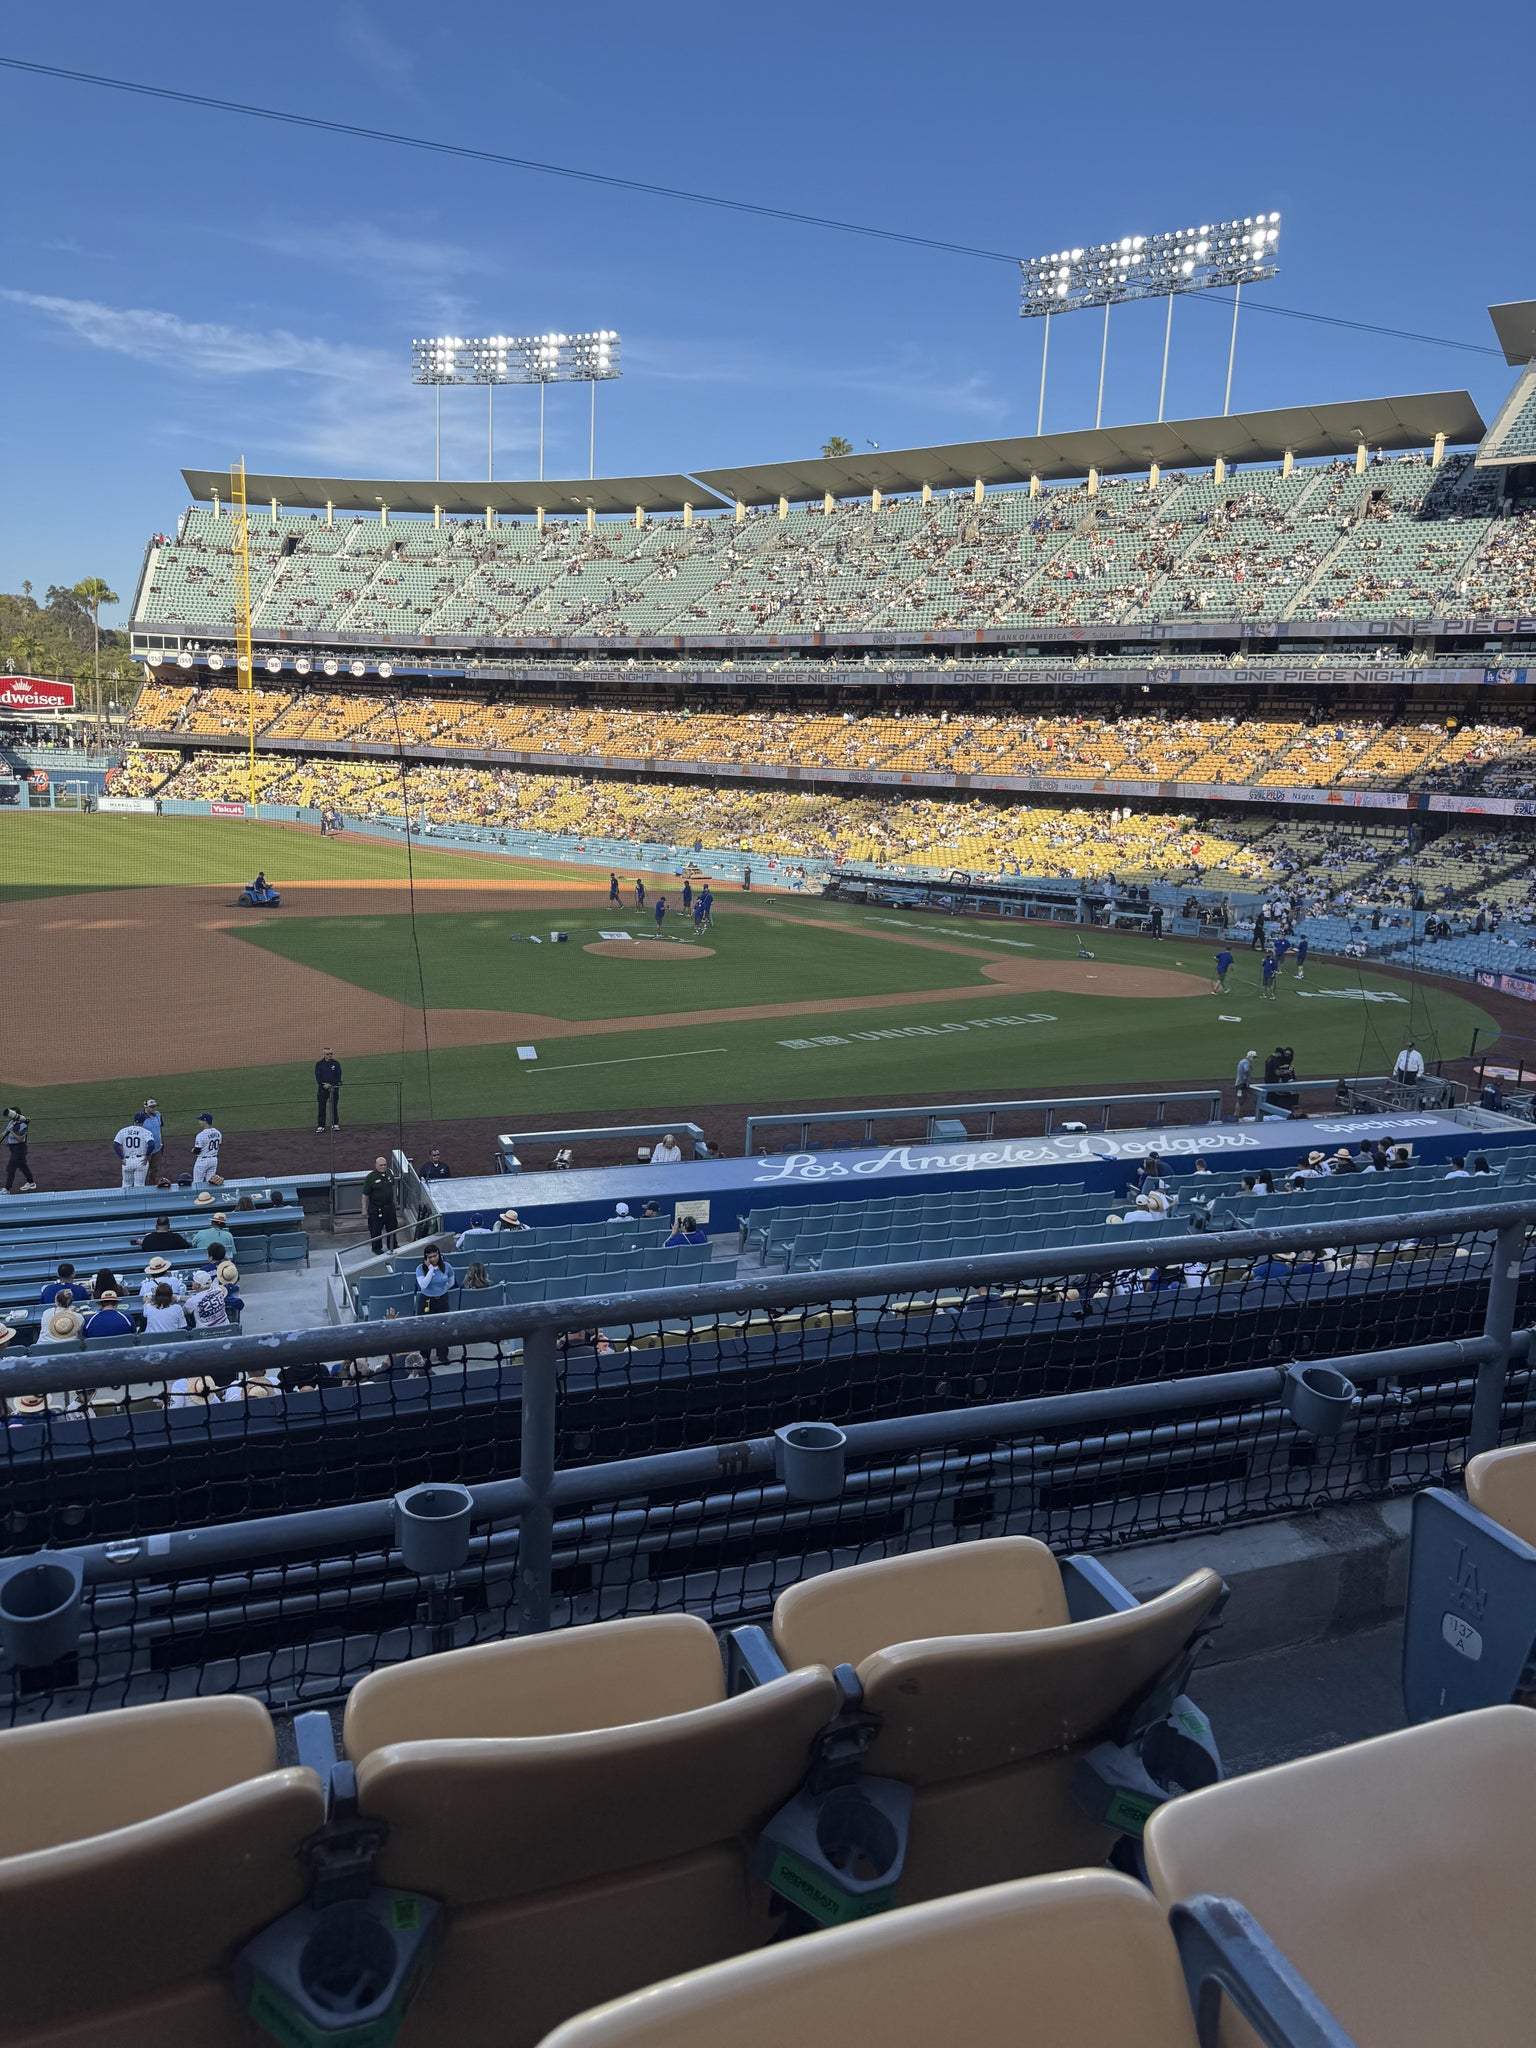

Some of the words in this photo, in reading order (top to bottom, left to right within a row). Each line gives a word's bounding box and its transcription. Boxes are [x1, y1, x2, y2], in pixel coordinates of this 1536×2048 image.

[1368, 620, 1432, 635] ONE
[1443, 619, 1536, 634] PIECE
[557, 672, 580, 680] ONE
[583, 673, 618, 681] PIECE
[618, 673, 650, 681] NIGHT
[736, 674, 761, 682] ONE
[766, 674, 806, 682] PIECE
[807, 674, 849, 683] NIGHT
[954, 673, 987, 682] ONE
[991, 672, 1040, 682] PIECE
[1045, 672, 1098, 682] NIGHT
[1234, 672, 1275, 681] ONE
[1283, 672, 1346, 682] PIECE
[1353, 671, 1422, 682] NIGHT
[1064, 783, 1083, 791] Night
[1292, 792, 1315, 801] Night
[848, 1022, 970, 1041] UNIQLO
[966, 1013, 1058, 1028] FIELD
[1314, 1117, 1435, 1134] Spectrum
[126, 1136, 141, 1148] 00
[753, 1154, 848, 1181] Los
[852, 1147, 1059, 1171] Angeles
[1053, 1133, 1260, 1158] Dodgers
[1455, 1639, 1465, 1652] A
